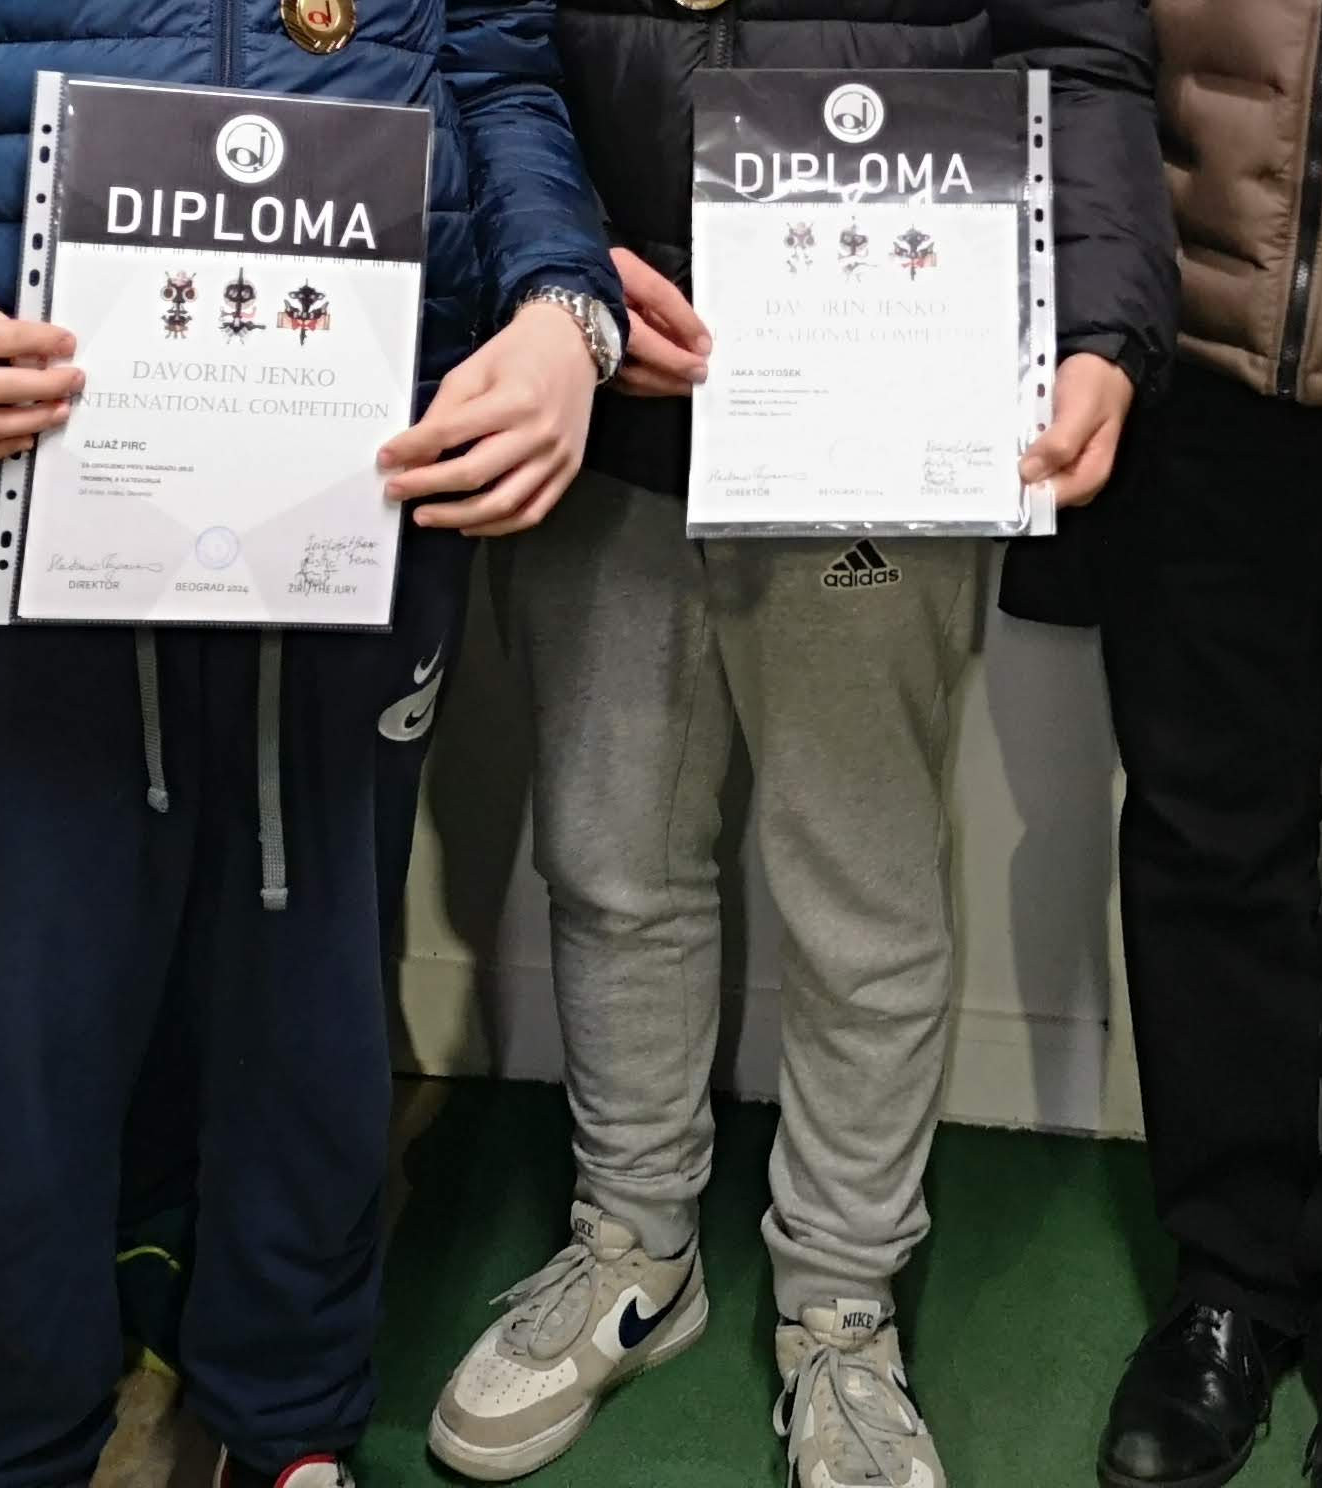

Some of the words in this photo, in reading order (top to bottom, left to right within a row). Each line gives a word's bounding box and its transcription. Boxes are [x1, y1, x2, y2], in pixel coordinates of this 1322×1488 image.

[734, 152, 974, 194] DIPLOMA
[107, 186, 377, 250] DIPLOMA
[131, 360, 249, 384] DAVORIN
[255, 366, 337, 388] JENKO
[248, 398, 390, 419] COMPETITION
[83, 438, 119, 450] ALJAŽ
[120, 440, 147, 451] PIRC
[68, 579, 121, 590] DIREKTOR
[174, 582, 225, 593] BEOGRAD
[823, 568, 900, 588] adidas
[841, 1311, 875, 1331] NIKE
